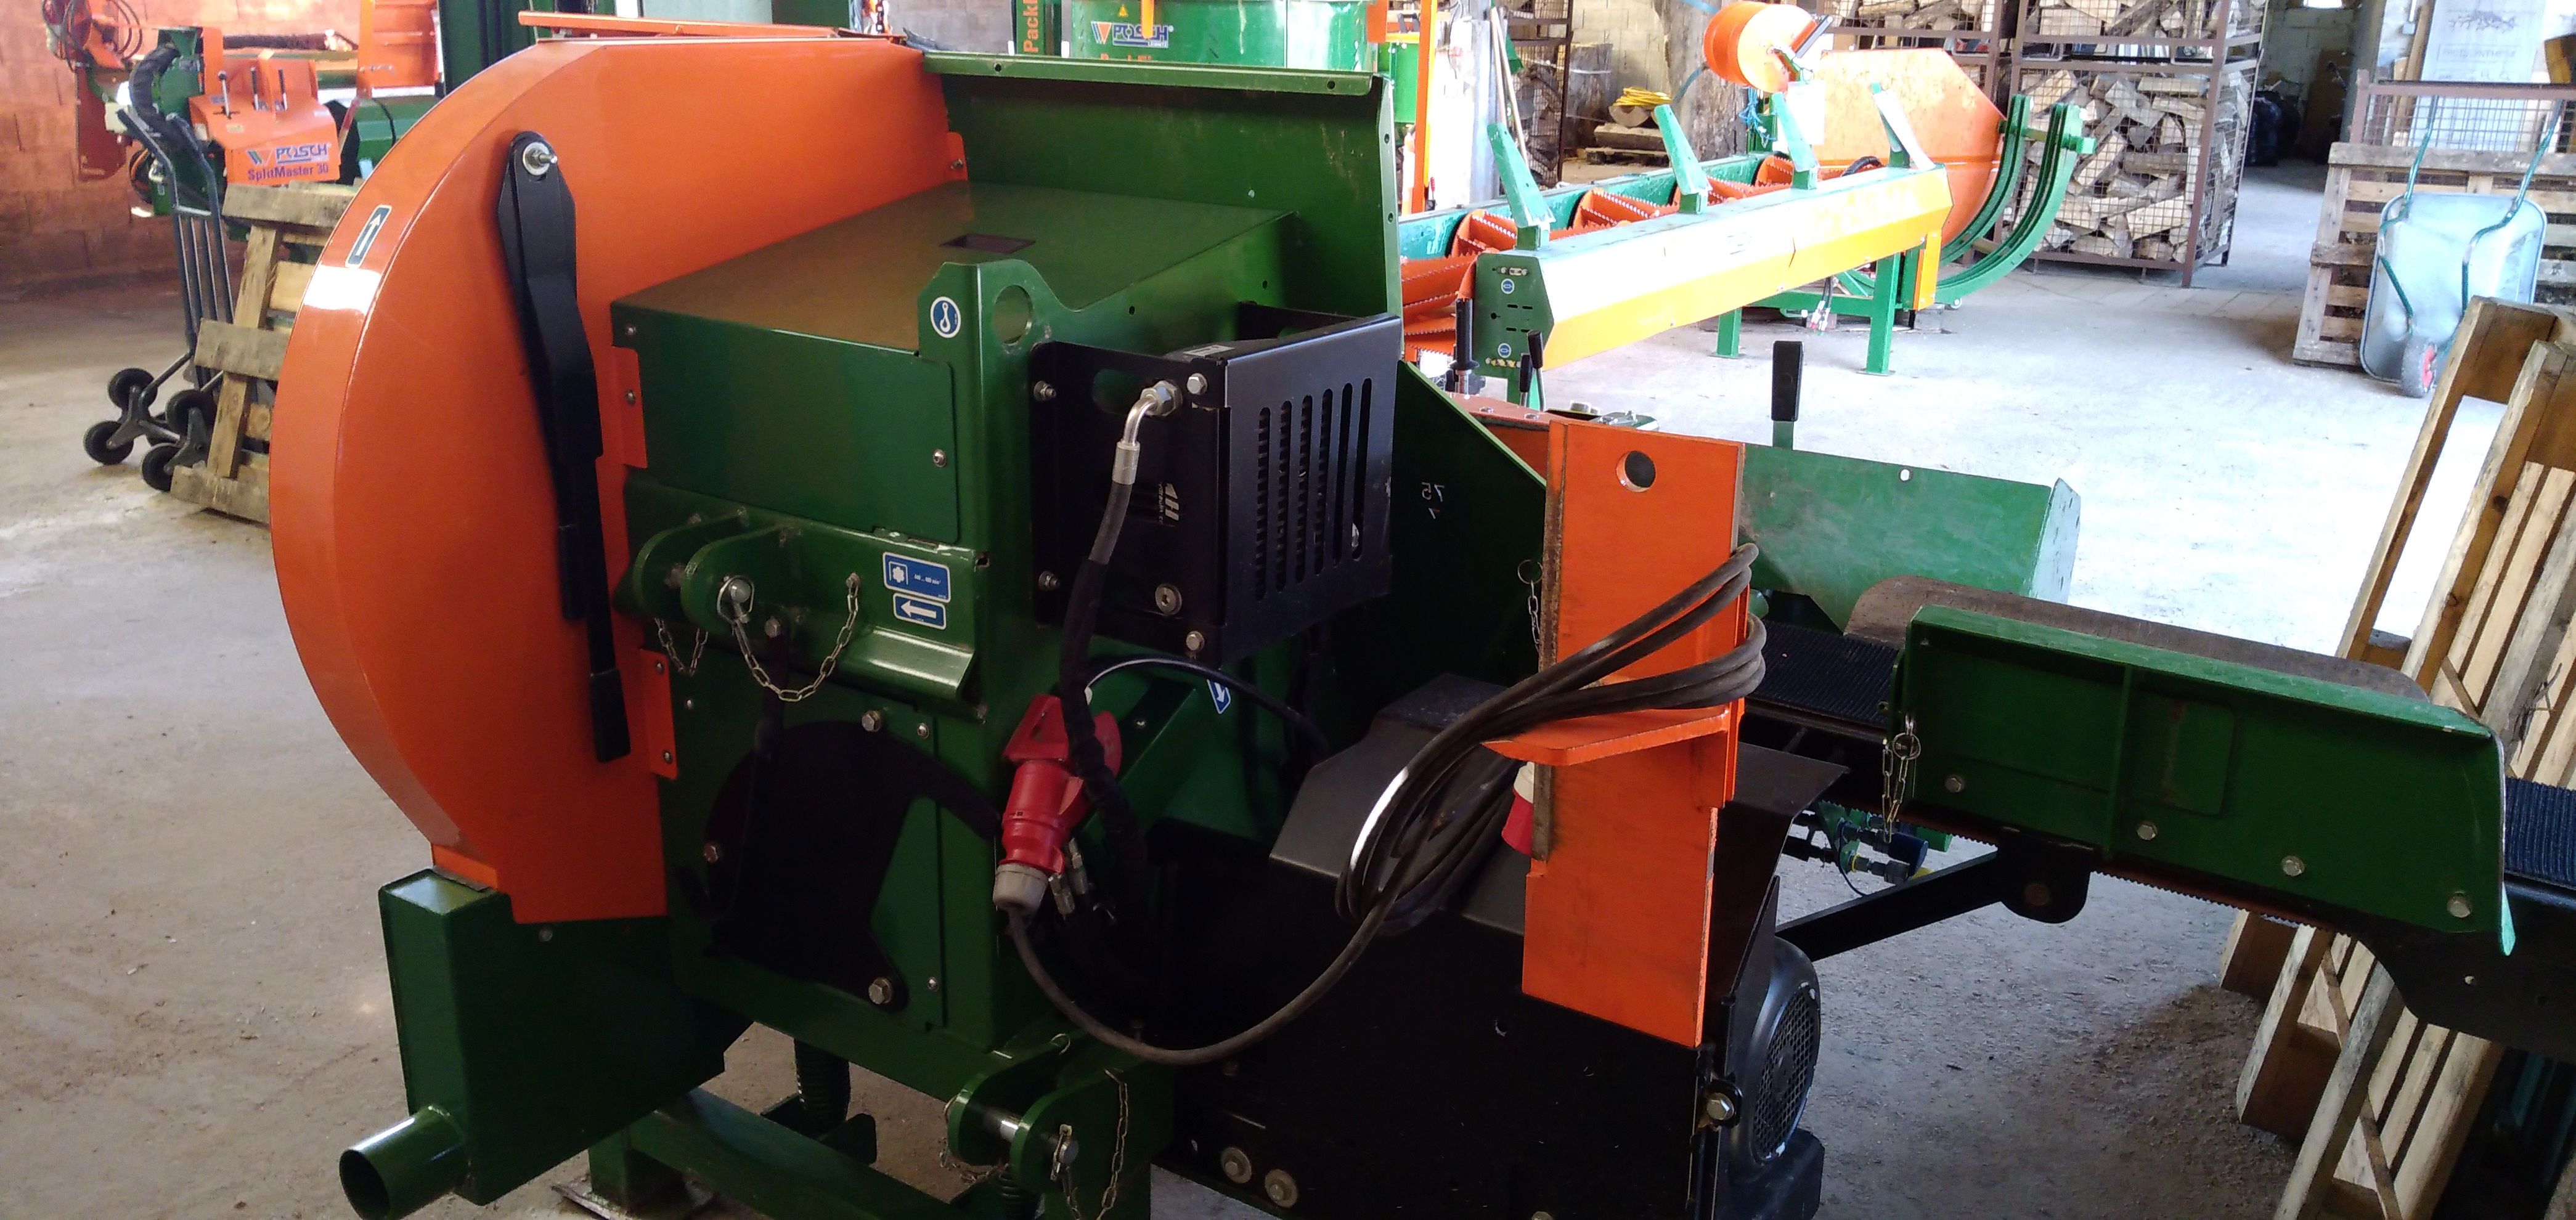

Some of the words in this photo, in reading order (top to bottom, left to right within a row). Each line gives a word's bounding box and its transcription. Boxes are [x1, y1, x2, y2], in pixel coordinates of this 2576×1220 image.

[1023, 0, 1038, 52] Pack
[1113, 25, 1167, 41] POSH
[276, 143, 328, 159] POSCH
[248, 166, 314, 182] SplitMaster
[317, 163, 328, 174] 30
